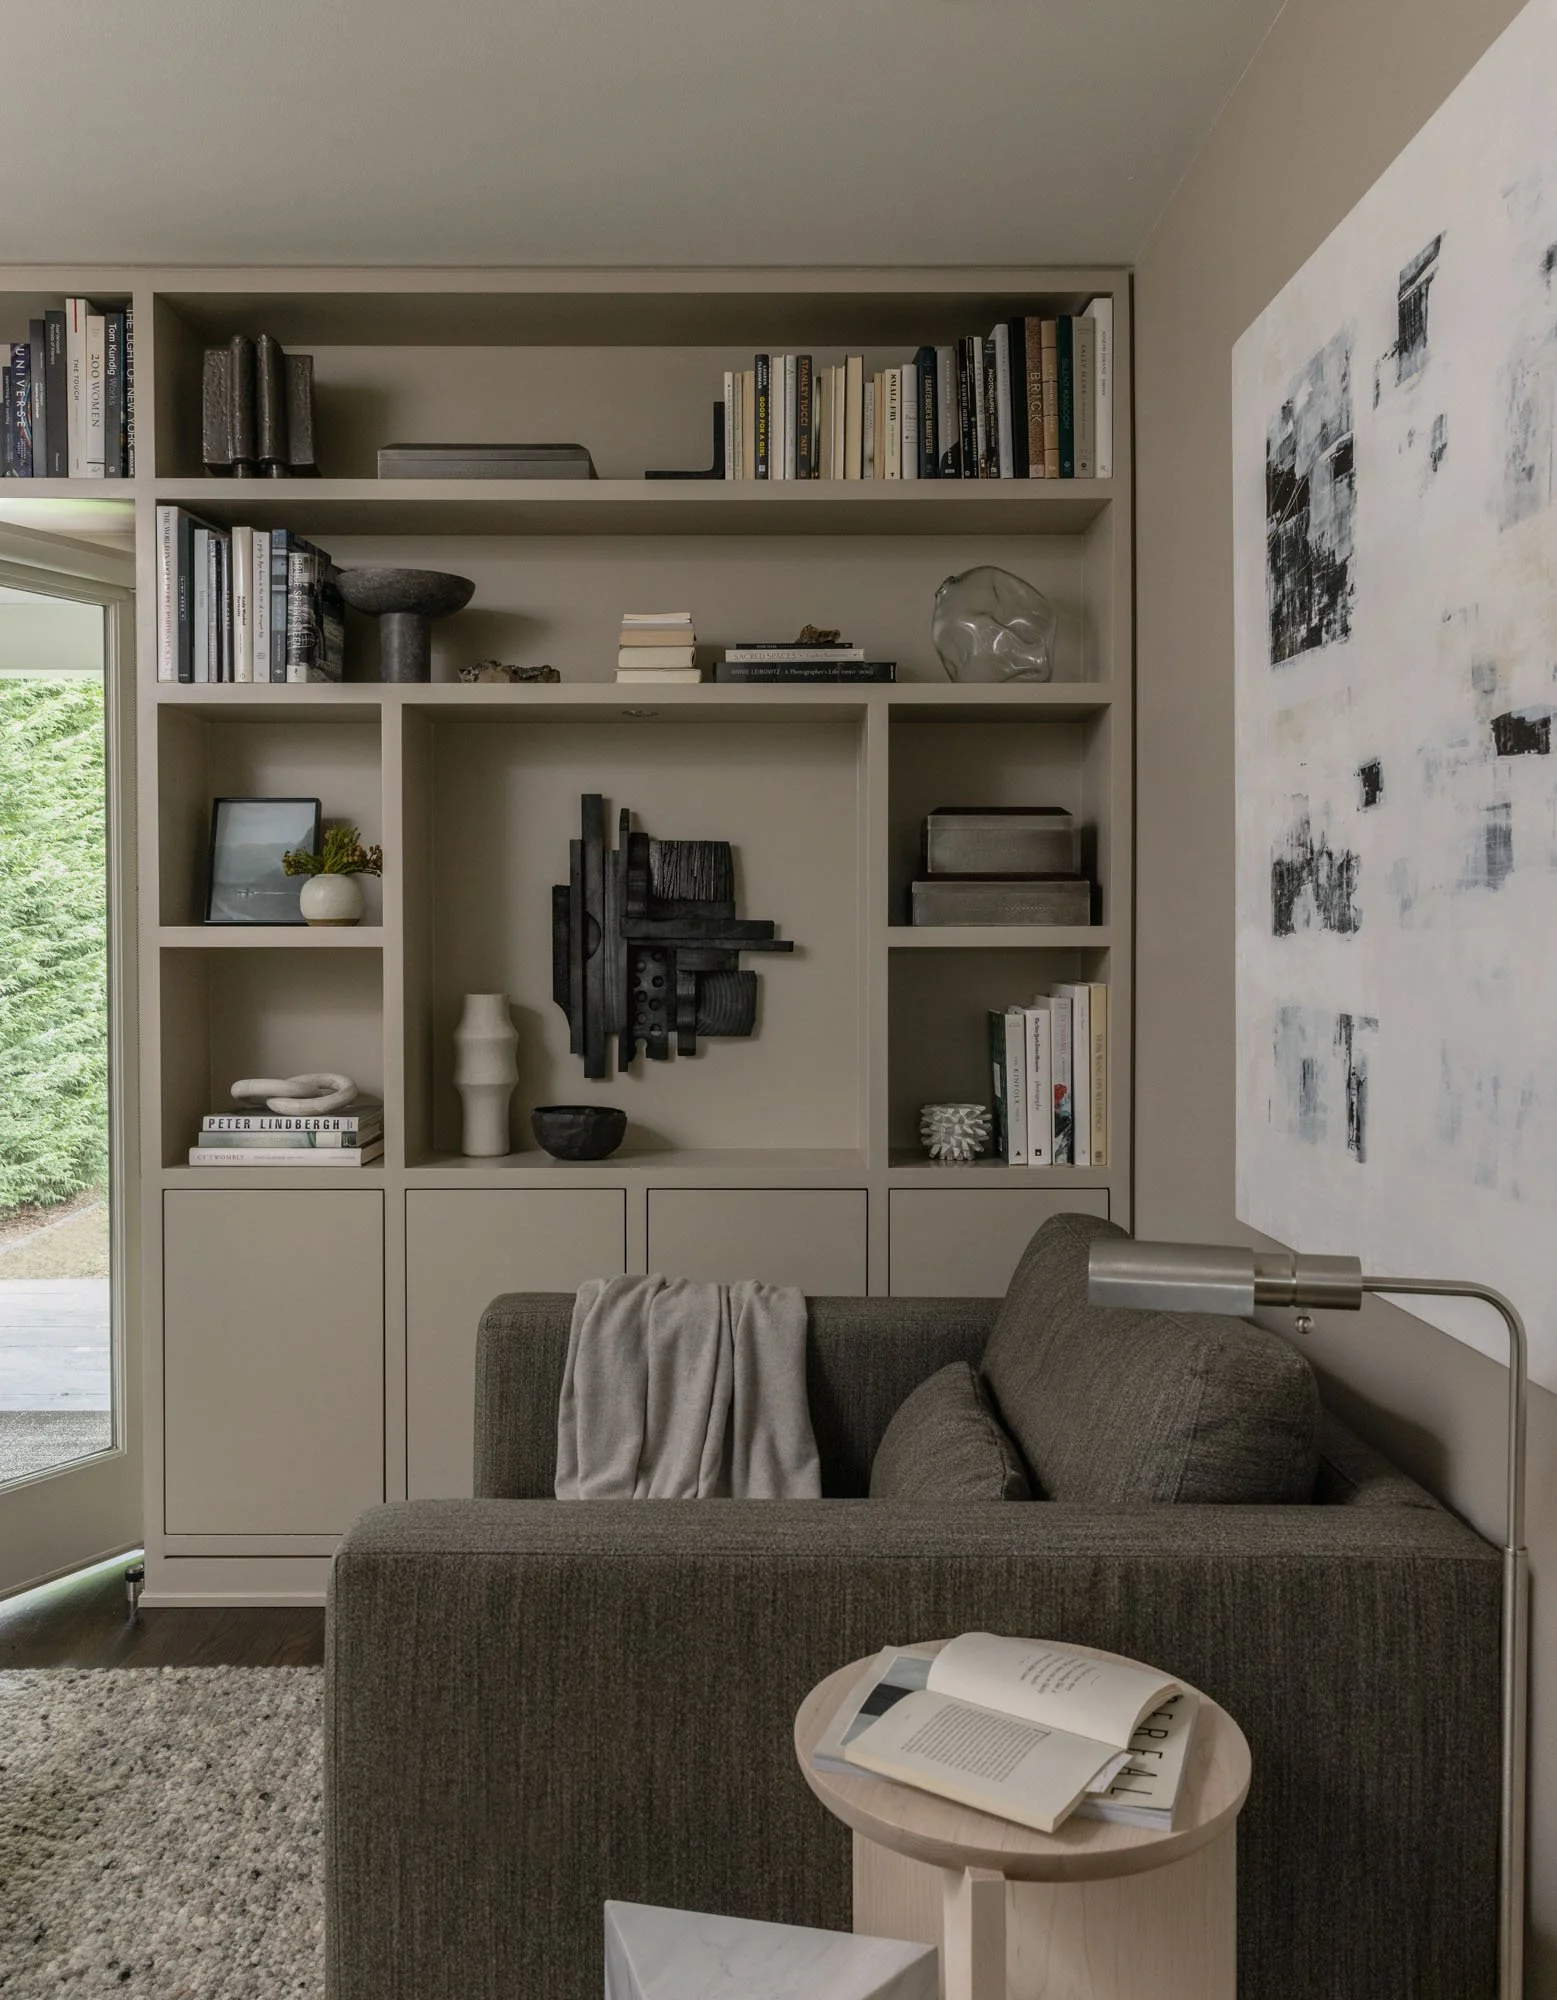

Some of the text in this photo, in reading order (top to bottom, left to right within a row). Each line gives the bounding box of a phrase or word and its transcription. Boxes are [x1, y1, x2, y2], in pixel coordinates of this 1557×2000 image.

[108, 323, 118, 343] Tom
[127, 333, 135, 364] LIGHT
[106, 345, 118, 377] Kundig
[127, 369, 135, 385] OF
[15, 348, 26, 428] UNIVERSE
[91, 353, 101, 429] 200 WOMEN
[127, 388, 135, 413] NEW
[801, 360, 809, 427] STANLEY TUCCI
[1030, 372, 1041, 423] BRICK
[127, 418, 135, 449] YORK
[292, 558, 302, 649] BRUCE SPRINGSTEEN
[208, 1118, 341, 1130] PETER LINDBERGH
[1110, 1694, 1184, 1795] EREAL
